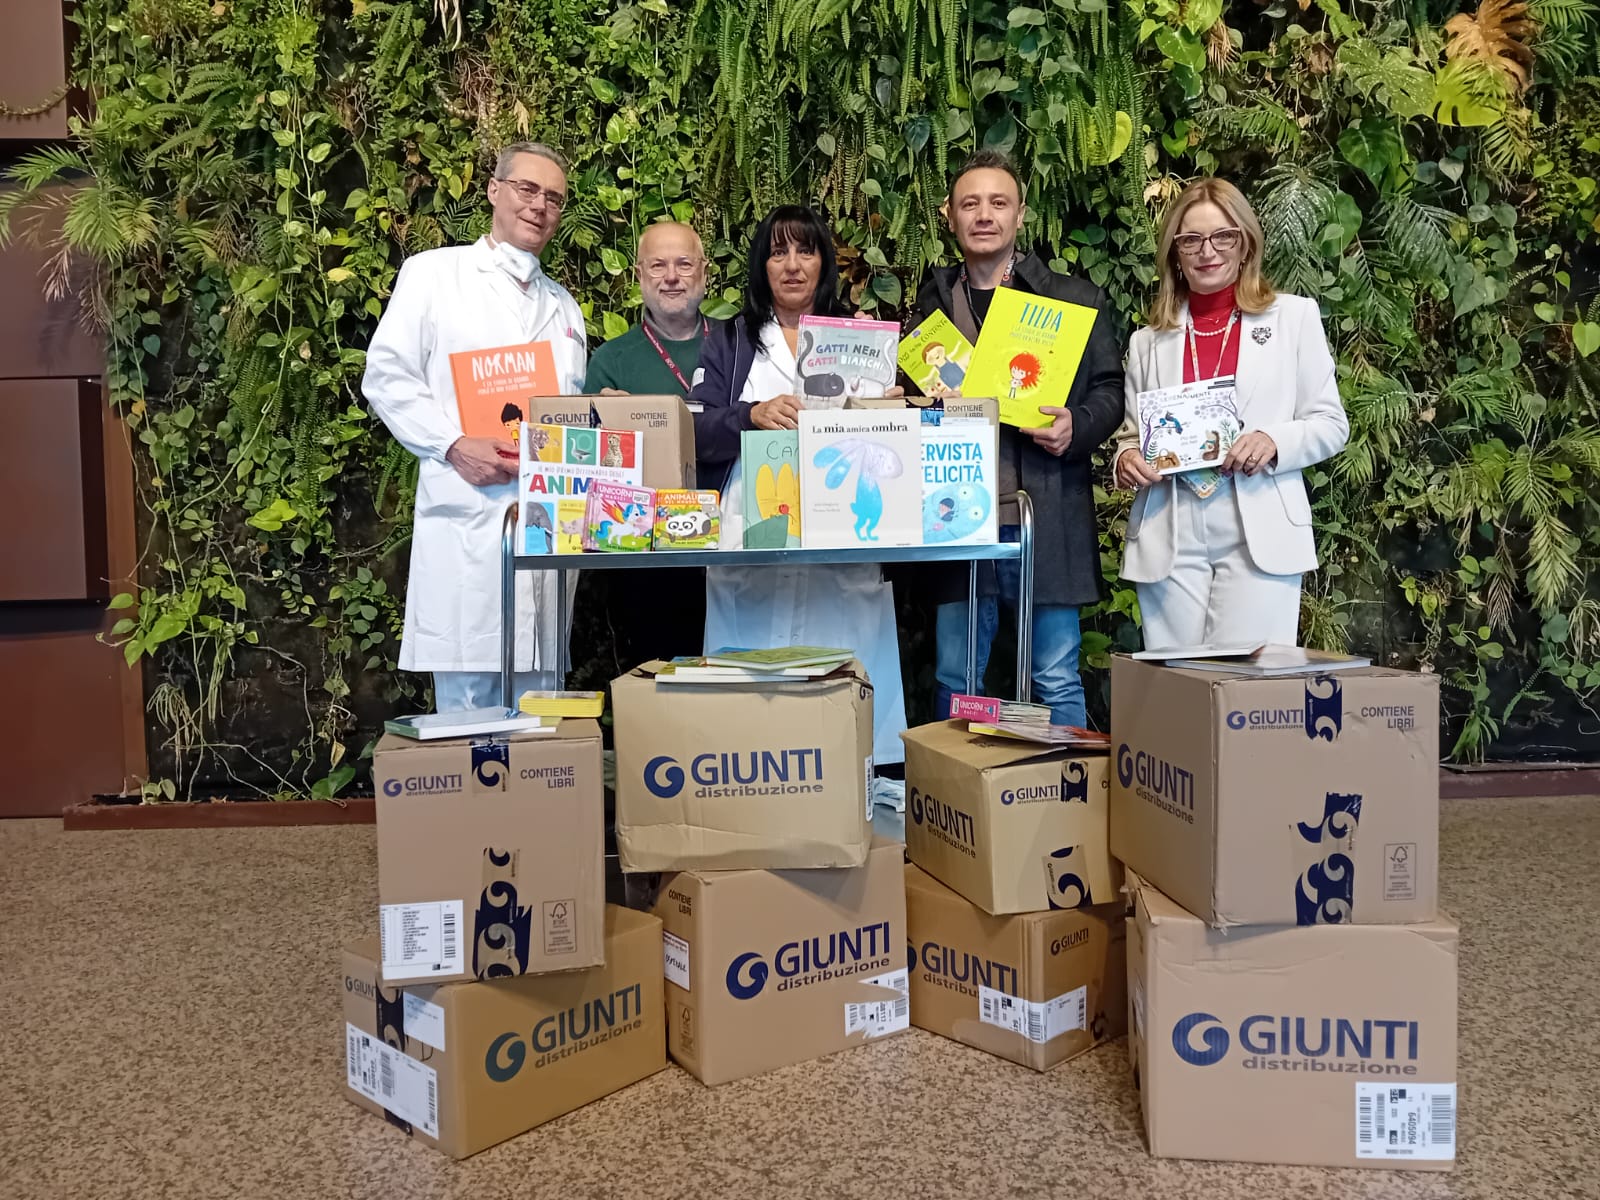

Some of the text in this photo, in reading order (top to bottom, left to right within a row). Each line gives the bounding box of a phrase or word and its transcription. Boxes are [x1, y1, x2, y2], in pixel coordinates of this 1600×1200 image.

[816, 344, 881, 358] GATTI NERI
[472, 351, 536, 382] NORMAN
[807, 355, 884, 371] GATTI BIANCHI
[630, 412, 668, 420] CONTIENE
[947, 404, 983, 413] CONTIENE
[554, 413, 591, 424] GIUNT
[648, 420, 668, 428] LIBRI
[812, 421, 909, 434] La mia amica ombra
[1249, 708, 1304, 725] GIUNTI
[1361, 705, 1415, 717] CONTIENE
[1387, 718, 1415, 729] LIBRI
[520, 766, 575, 780] CONTIENE
[691, 748, 824, 786] GIUNTI
[405, 774, 463, 792] GIUNTI
[547, 777, 575, 789] LIBRI
[1135, 750, 1195, 811] GIUNTI
[694, 783, 824, 799] distribuzione
[1016, 784, 1059, 800] GIUNTI
[1135, 785, 1195, 825] distribuzione
[925, 793, 976, 847] GIUNTI
[927, 823, 977, 859] distribuzione
[668, 888, 693, 906] CONTIENE
[679, 903, 692, 917] LIBRI
[1061, 927, 1090, 949] GIUNTI
[774, 921, 891, 978] GIUNTI
[777, 956, 891, 992] distribuzione
[921, 941, 1018, 998] GIUNTI
[923, 971, 976, 999] distribu
[532, 983, 642, 1054] GIUNTI
[535, 1018, 643, 1069] distribuzione
[1239, 1014, 1419, 1060] GIUNTI
[1241, 1056, 1418, 1076] distribuzione
